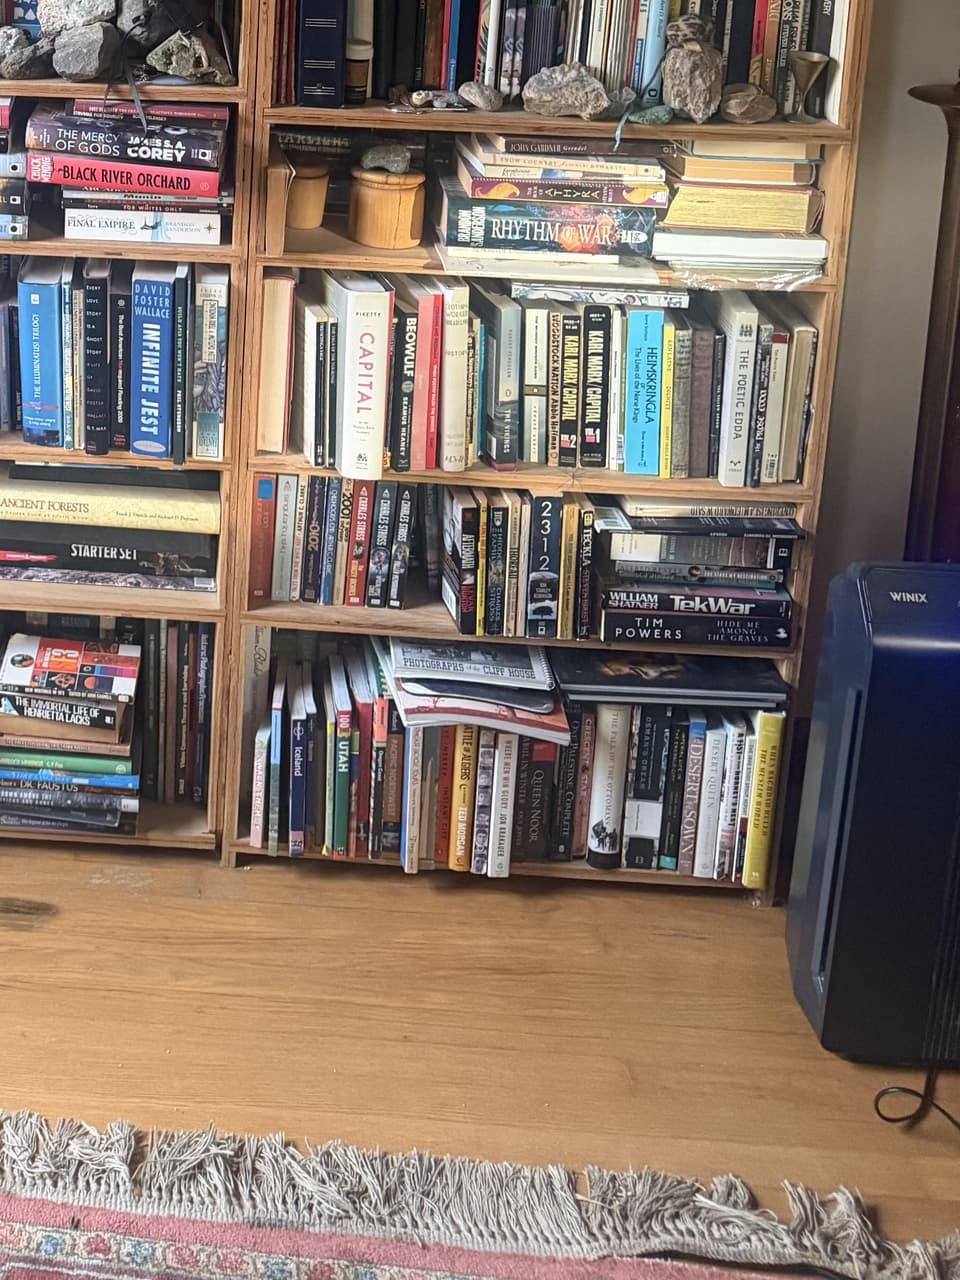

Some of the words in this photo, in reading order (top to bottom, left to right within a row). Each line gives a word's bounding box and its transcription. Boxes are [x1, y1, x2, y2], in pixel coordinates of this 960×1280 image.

[57, 128, 79, 140] THE
[81, 130, 120, 143] MERCY
[55, 140, 75, 151] OF
[78, 143, 120, 156] GODS
[63, 165, 97, 182] BLACK
[101, 169, 133, 185] RIVER
[137, 173, 191, 191] ORCHARD
[492, 219, 561, 242] RHYTHM
[135, 284, 171, 297] DAVID
[135, 295, 170, 308] FOSTER
[134, 306, 170, 319] WALLACE
[403, 317, 417, 377] BEOWULF
[141, 323, 160, 394] INFINITE
[740, 350, 749, 370] THE
[356, 332, 375, 414] CAPITAL
[645, 347, 658, 424] HEIMSKRINGLA
[737, 373, 748, 407] POETIC
[140, 399, 160, 435] JEST
[733, 410, 744, 440] EDDA
[0, 498, 45, 510] ANCIENT
[47, 501, 90, 513] FORESTS
[71, 544, 118, 559] STARTER
[119, 548, 137, 561] SET
[608, 598, 659, 610] SHATNER
[609, 591, 658, 603] WILLIAM
[670, 595, 756, 615] TekWar
[889, 591, 928, 603] WINIX
[635, 617, 663, 628] TIM
[615, 628, 682, 640] POWERS
[403, 658, 464, 672] PHOTOGRAPHS
[294, 746, 303, 777] Iceland
[337, 740, 350, 773] UTAH
